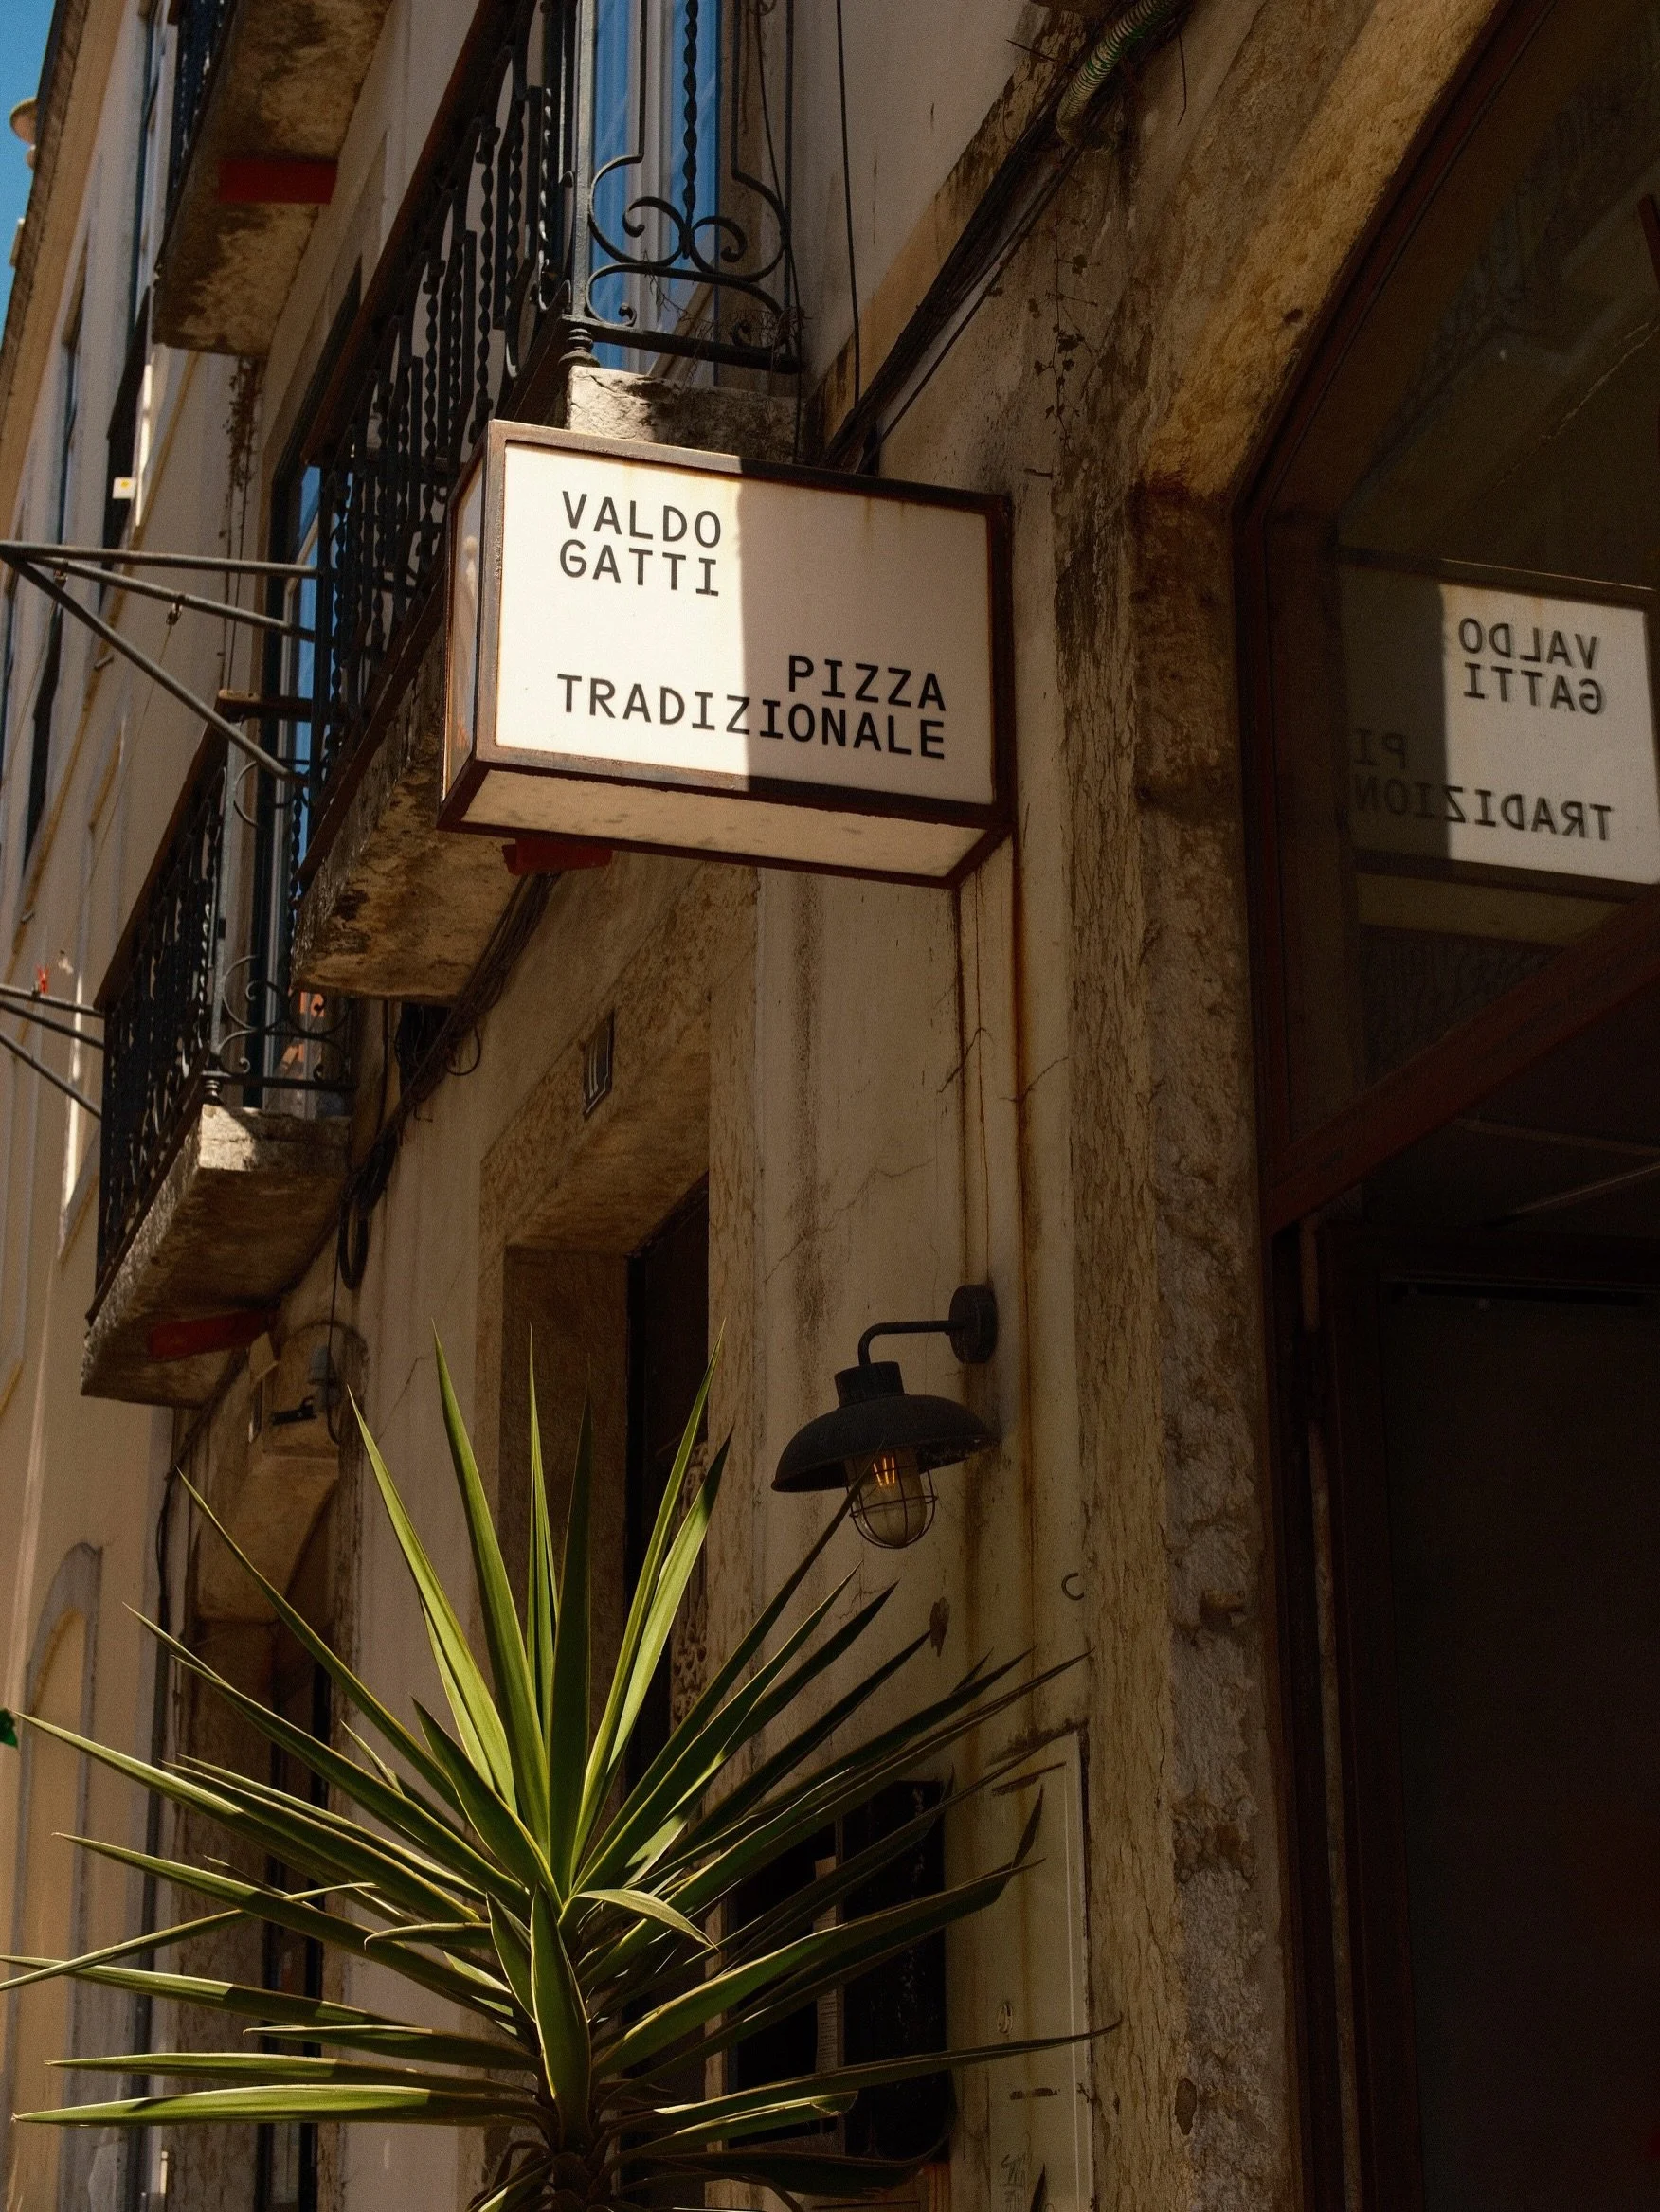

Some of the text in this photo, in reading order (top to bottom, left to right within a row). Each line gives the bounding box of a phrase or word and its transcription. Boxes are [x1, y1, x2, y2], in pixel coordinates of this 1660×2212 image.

[561, 491, 722, 549] VALDO
[560, 540, 719, 598] GATTI
[788, 655, 947, 711] PIZZA
[557, 674, 945, 760] TRADIZIONALE
